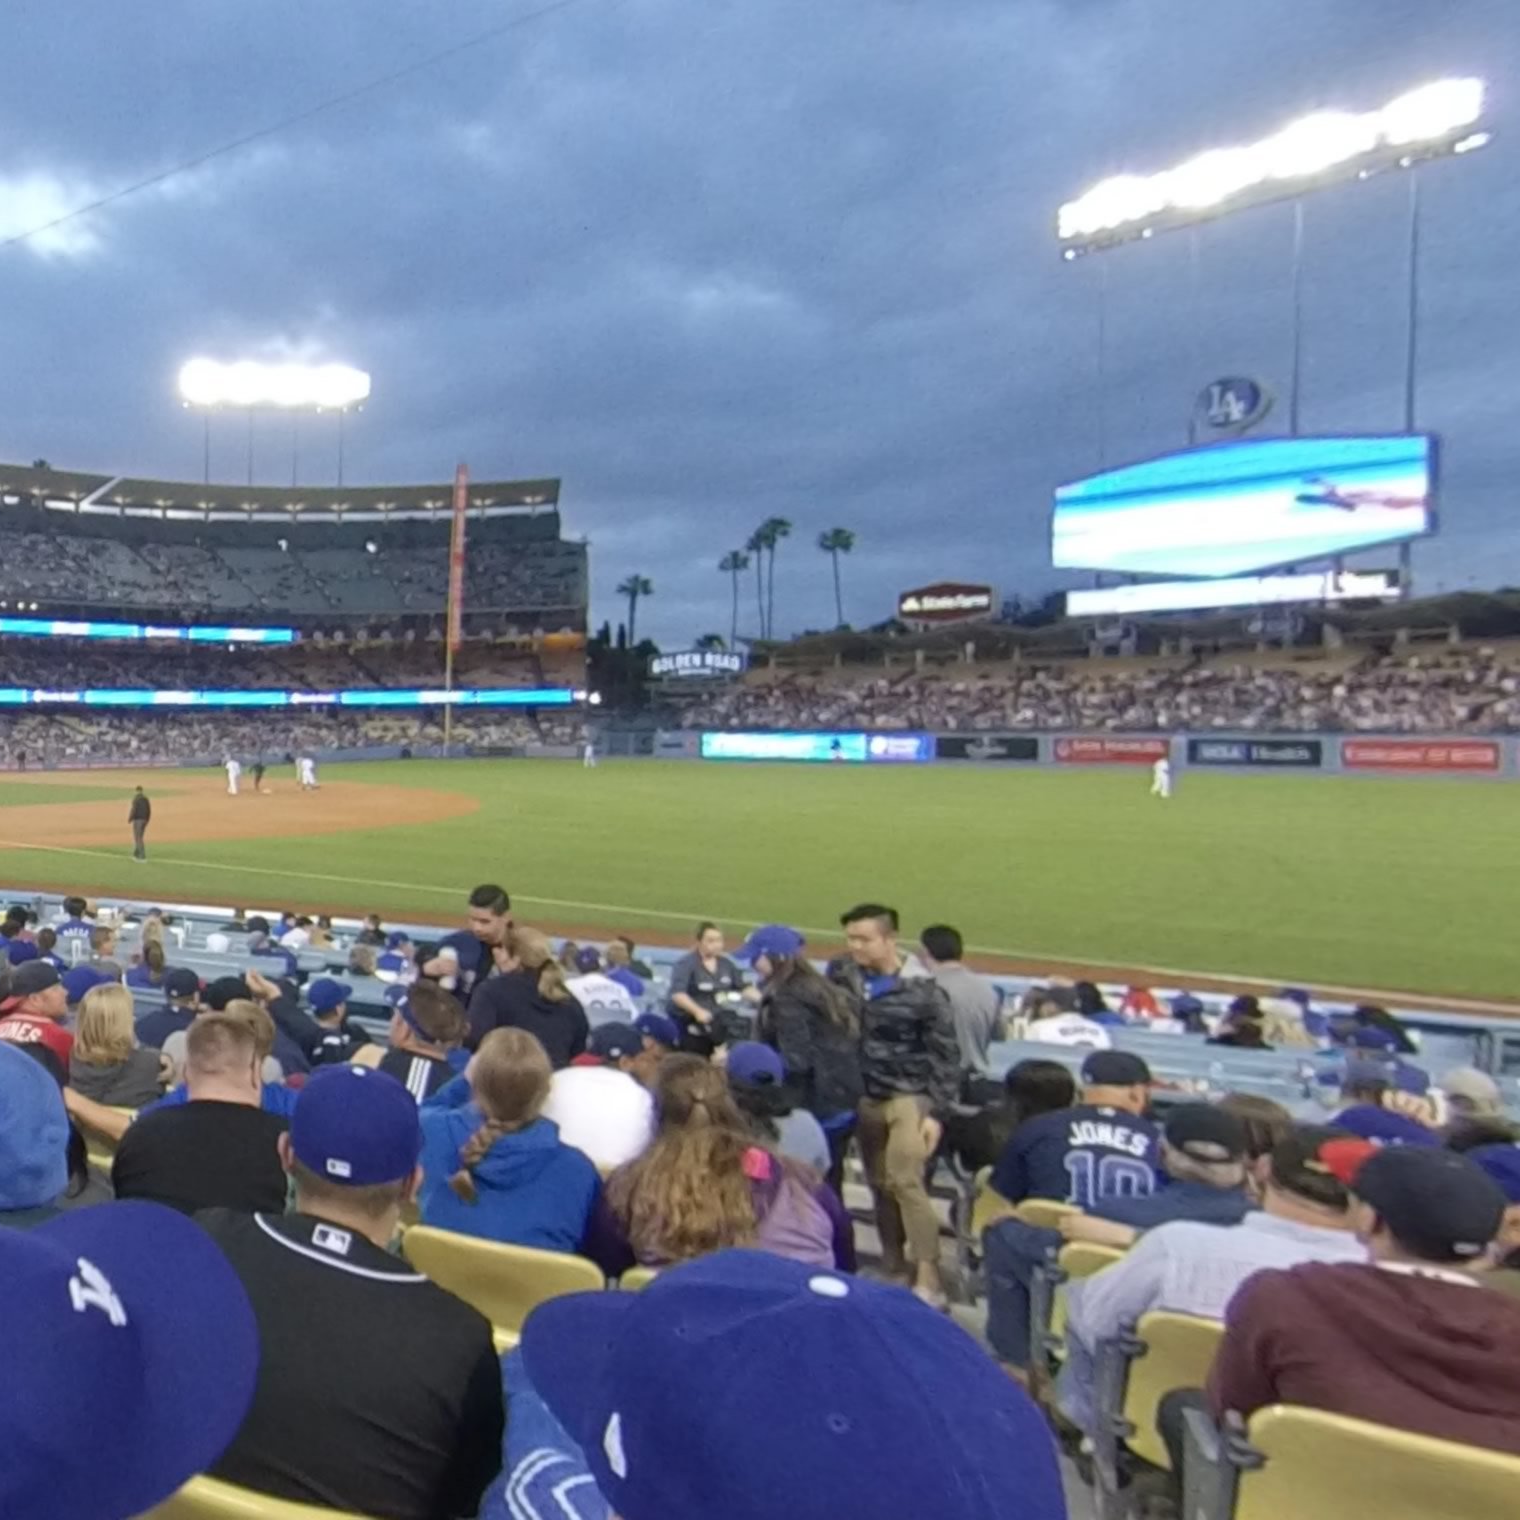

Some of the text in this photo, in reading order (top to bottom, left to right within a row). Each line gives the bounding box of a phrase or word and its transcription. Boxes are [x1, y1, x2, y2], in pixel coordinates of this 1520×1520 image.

[1207, 386, 1245, 421] LA
[652, 653, 701, 674] GOLDEN
[705, 652, 740, 671] ROAD
[1068, 1120, 1150, 1156] JONES
[1063, 1149, 1155, 1207] 10
